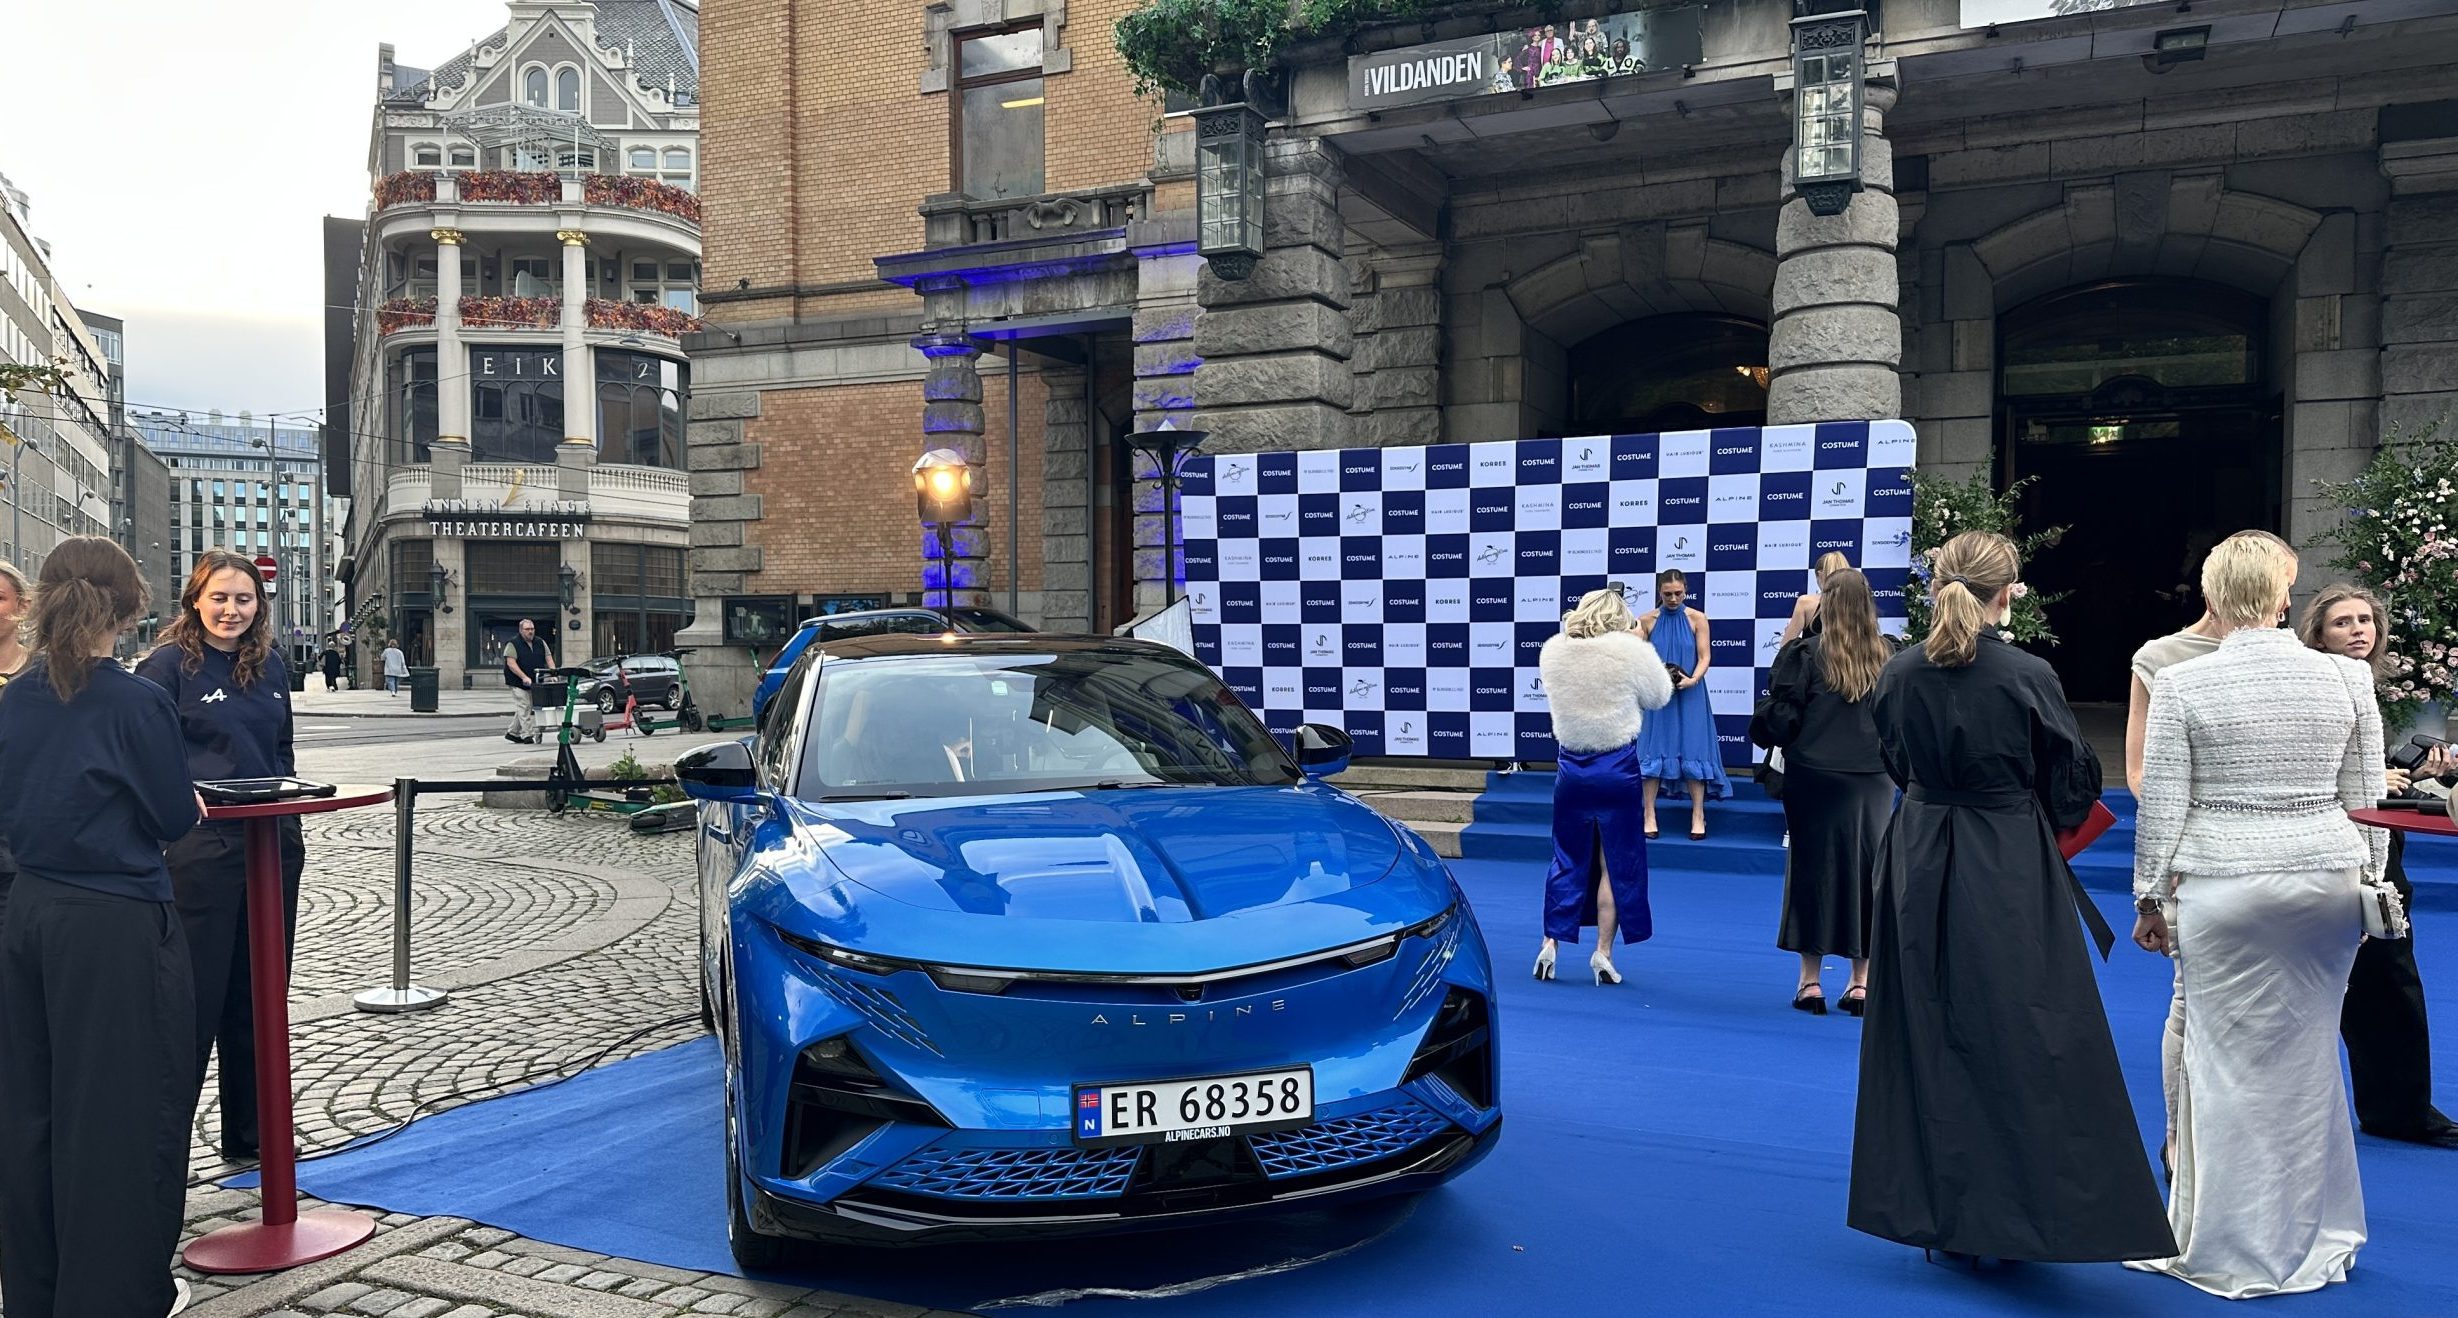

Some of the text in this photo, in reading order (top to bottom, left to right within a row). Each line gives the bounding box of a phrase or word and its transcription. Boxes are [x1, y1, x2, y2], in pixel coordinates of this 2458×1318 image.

[1370, 52, 1482, 95] VILDANDEN
[483, 357, 557, 376] EIK
[1821, 440, 1860, 450] COSTUME
[1716, 446, 1753, 455] COSTUME
[1616, 452, 1652, 462] COSTUME
[1431, 462, 1463, 471] COSTUME
[1522, 458, 1555, 467] COSTUME
[1262, 469, 1292, 477] COSTUME
[1345, 466, 1376, 474] COSTUME
[1766, 492, 1804, 501] COSTUME
[1873, 488, 1912, 497] COSTUME
[1619, 499, 1649, 507] KORRES
[1664, 496, 1700, 505] COSTUME
[1476, 505, 1508, 514] COSTUME
[1568, 501, 1602, 510] COSTUME
[1222, 513, 1251, 521] COSTUME
[1304, 511, 1334, 519] COSTUME
[1388, 509, 1419, 517] COSTUME
[430, 521, 585, 538] THEATERCAFEEN
[1713, 543, 1750, 552] COSTUME
[1816, 540, 1854, 549] COSTUME
[1521, 550, 1554, 558] COSTUME
[1614, 546, 1649, 555] COSTUME
[1346, 554, 1376, 562] COSTUME
[1431, 552, 1463, 560] COSTUME
[1763, 591, 1799, 599] COSTUME
[1306, 599, 1335, 607] COSTUME
[1388, 598, 1419, 606] COSTUME
[1475, 597, 1508, 605] COSTUME
[1711, 639, 1747, 647] COSTUME
[1390, 686, 1421, 694] COSTUME
[1475, 687, 1508, 695] COSTUME
[1433, 730, 1464, 738] COSTUME
[1091, 1000, 1284, 1024] ALPINE
[1111, 1078, 1300, 1128] ER 68358
[1084, 1119, 1094, 1130] N
[1165, 1126, 1230, 1142] ALPINECARS.NO
